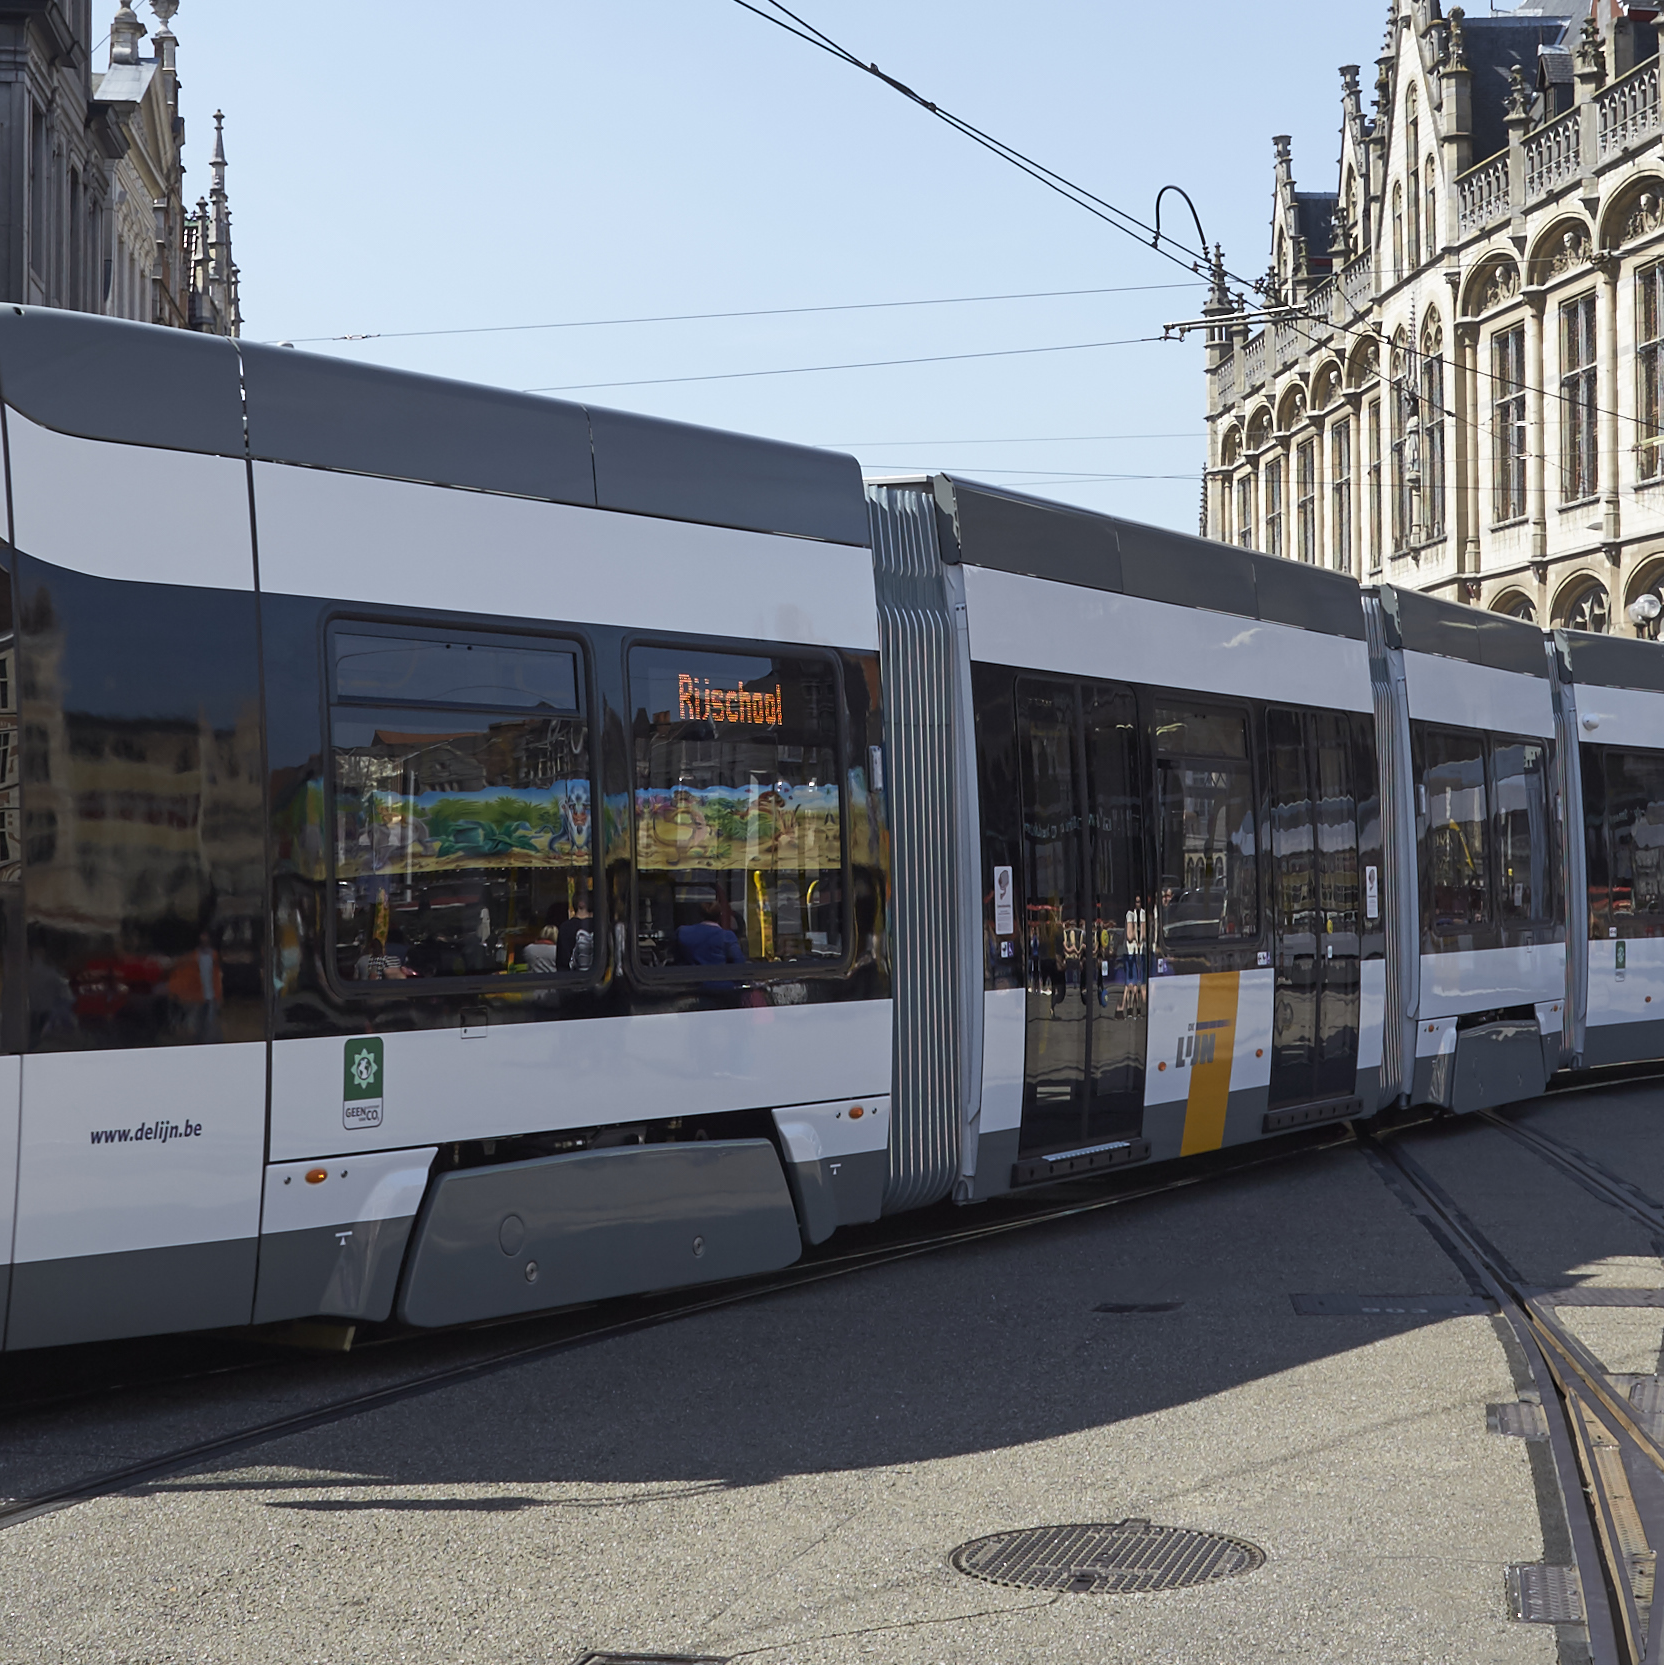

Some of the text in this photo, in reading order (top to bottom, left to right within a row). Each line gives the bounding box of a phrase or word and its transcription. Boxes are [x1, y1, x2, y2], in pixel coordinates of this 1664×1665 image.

[677, 673, 783, 726] Rijschool
[1175, 1033, 1216, 1069] LIJN
[345, 1107, 366, 1118] GEEN
[90, 1119, 203, 1145] www.delijn.be
